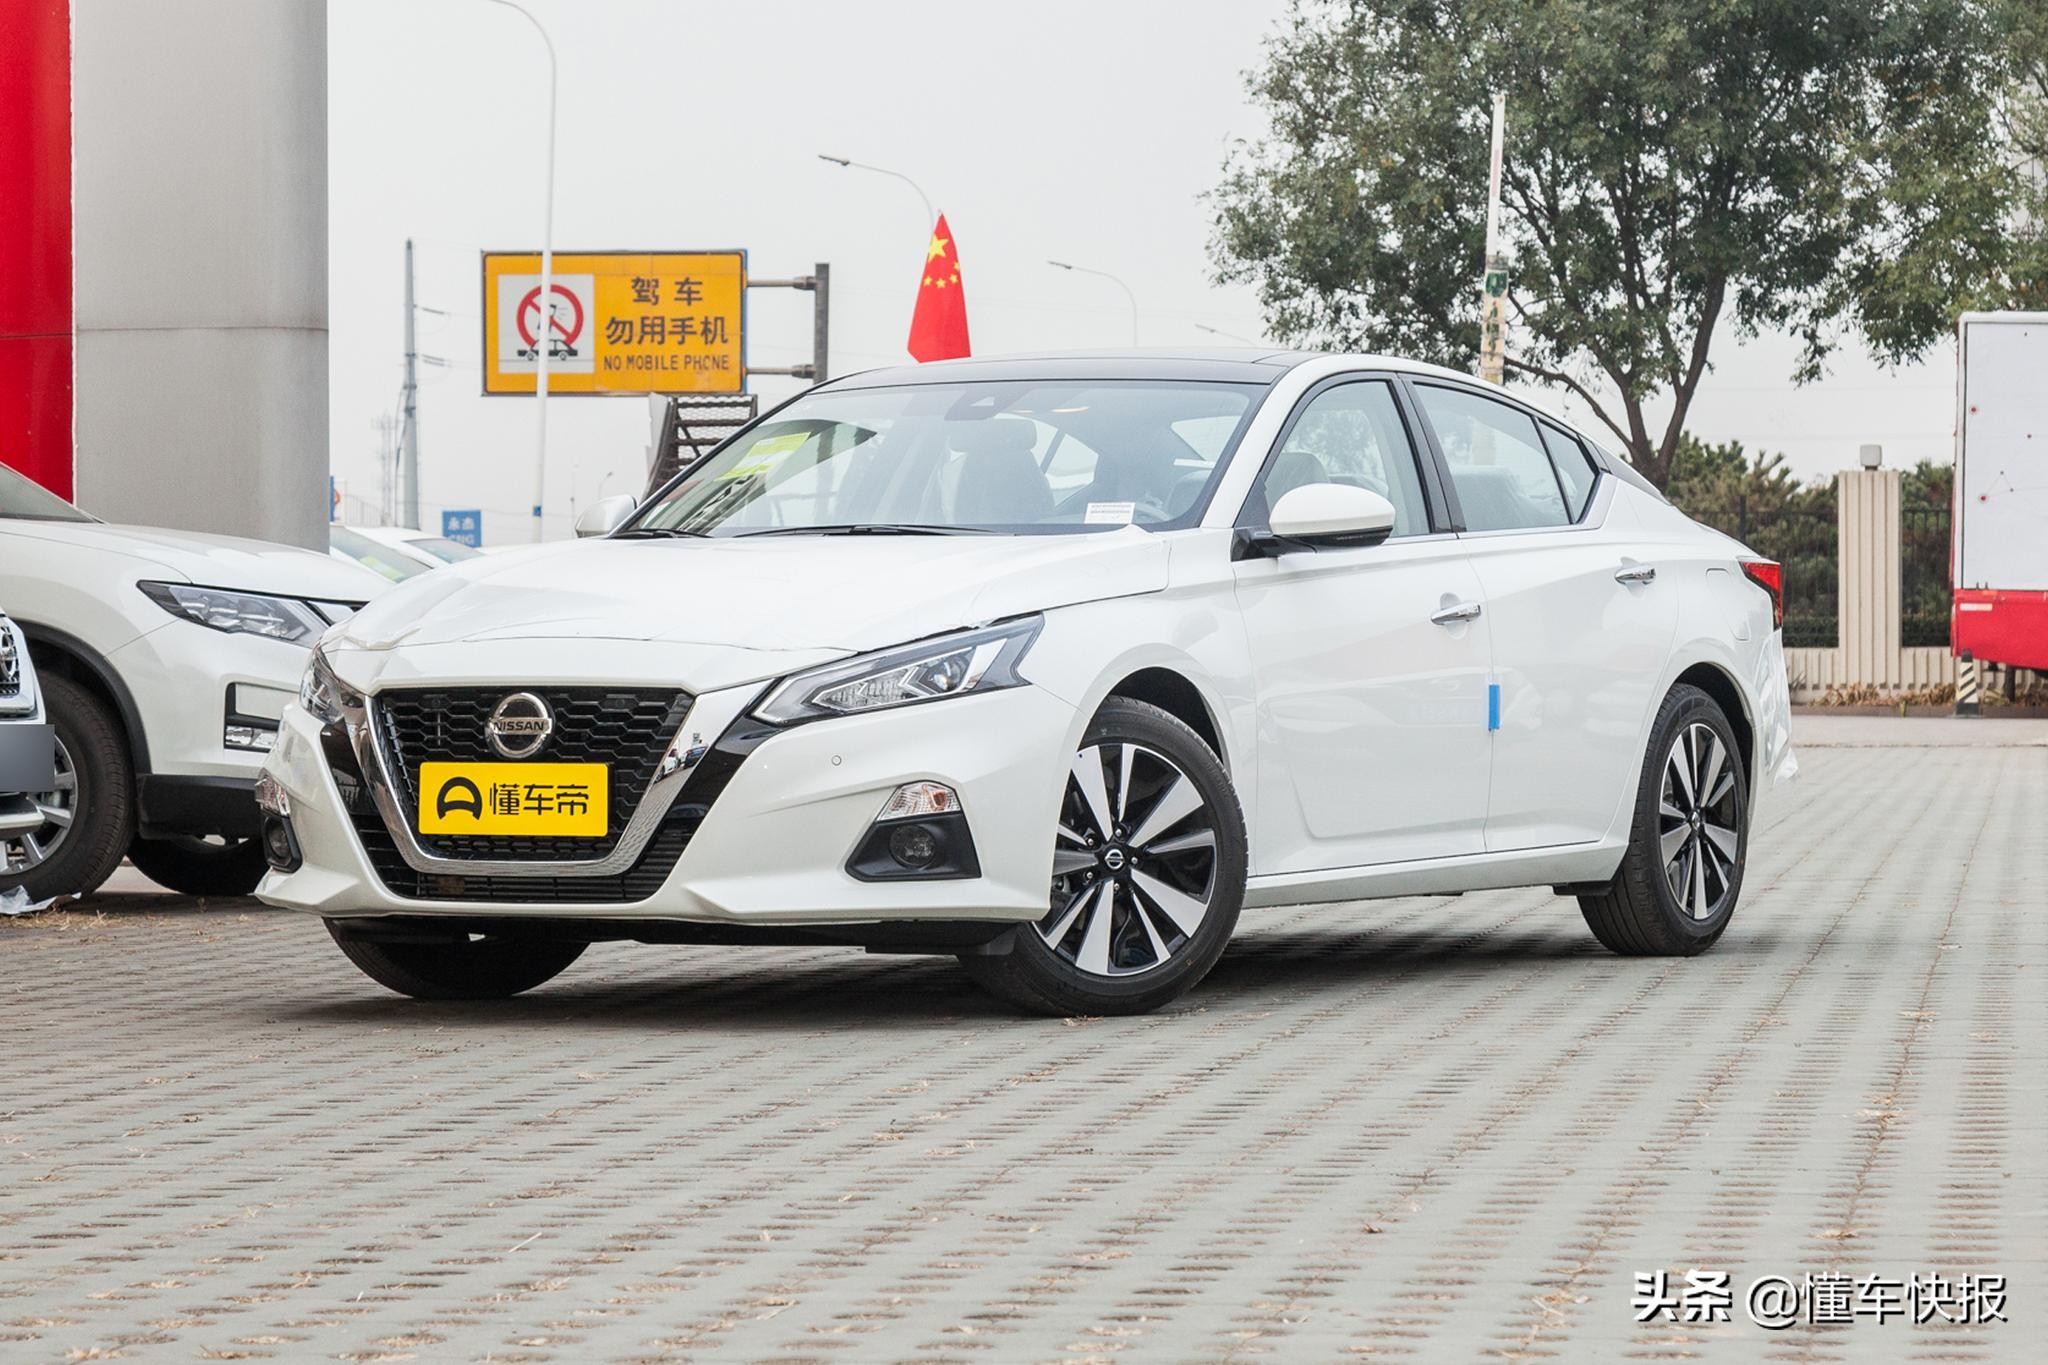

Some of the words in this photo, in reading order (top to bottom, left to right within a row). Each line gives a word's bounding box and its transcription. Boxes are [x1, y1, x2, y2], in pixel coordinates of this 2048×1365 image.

[631, 276, 703, 306] 驾车
[605, 316, 728, 345] 勿用手机
[603, 355, 621, 370] NO
[626, 355, 678, 370] MOBILE
[493, 720, 545, 732] NISSAN
[489, 782, 589, 816] 懂车帝
